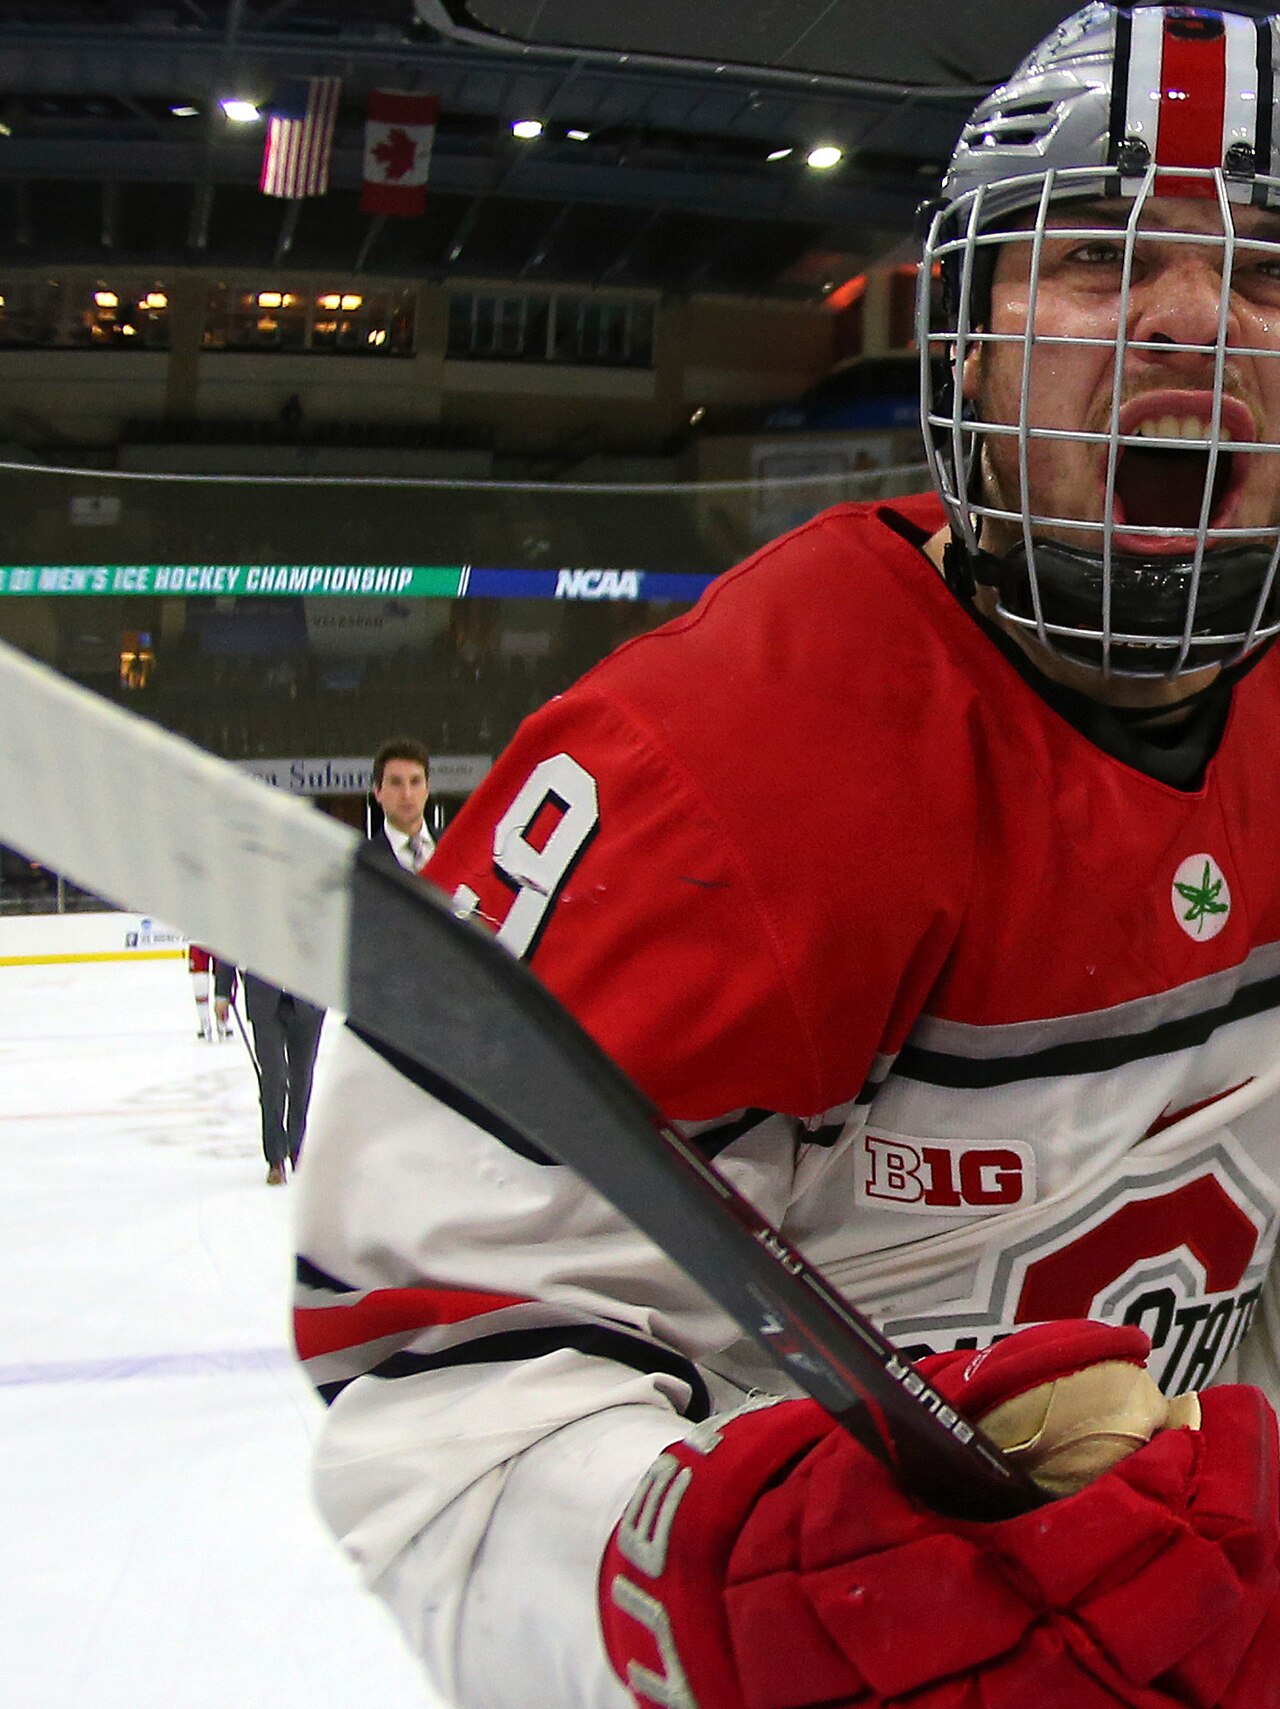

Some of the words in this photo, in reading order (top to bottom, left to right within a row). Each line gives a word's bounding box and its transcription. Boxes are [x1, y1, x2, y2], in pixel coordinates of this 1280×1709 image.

[38, 566, 108, 592] MEN'S
[112, 566, 149, 592] ICE
[154, 566, 240, 592] HOCKEY
[245, 566, 414, 592] CHAMPIONSHIP
[555, 569, 637, 600] NCAA
[289, 760, 373, 788] Subar
